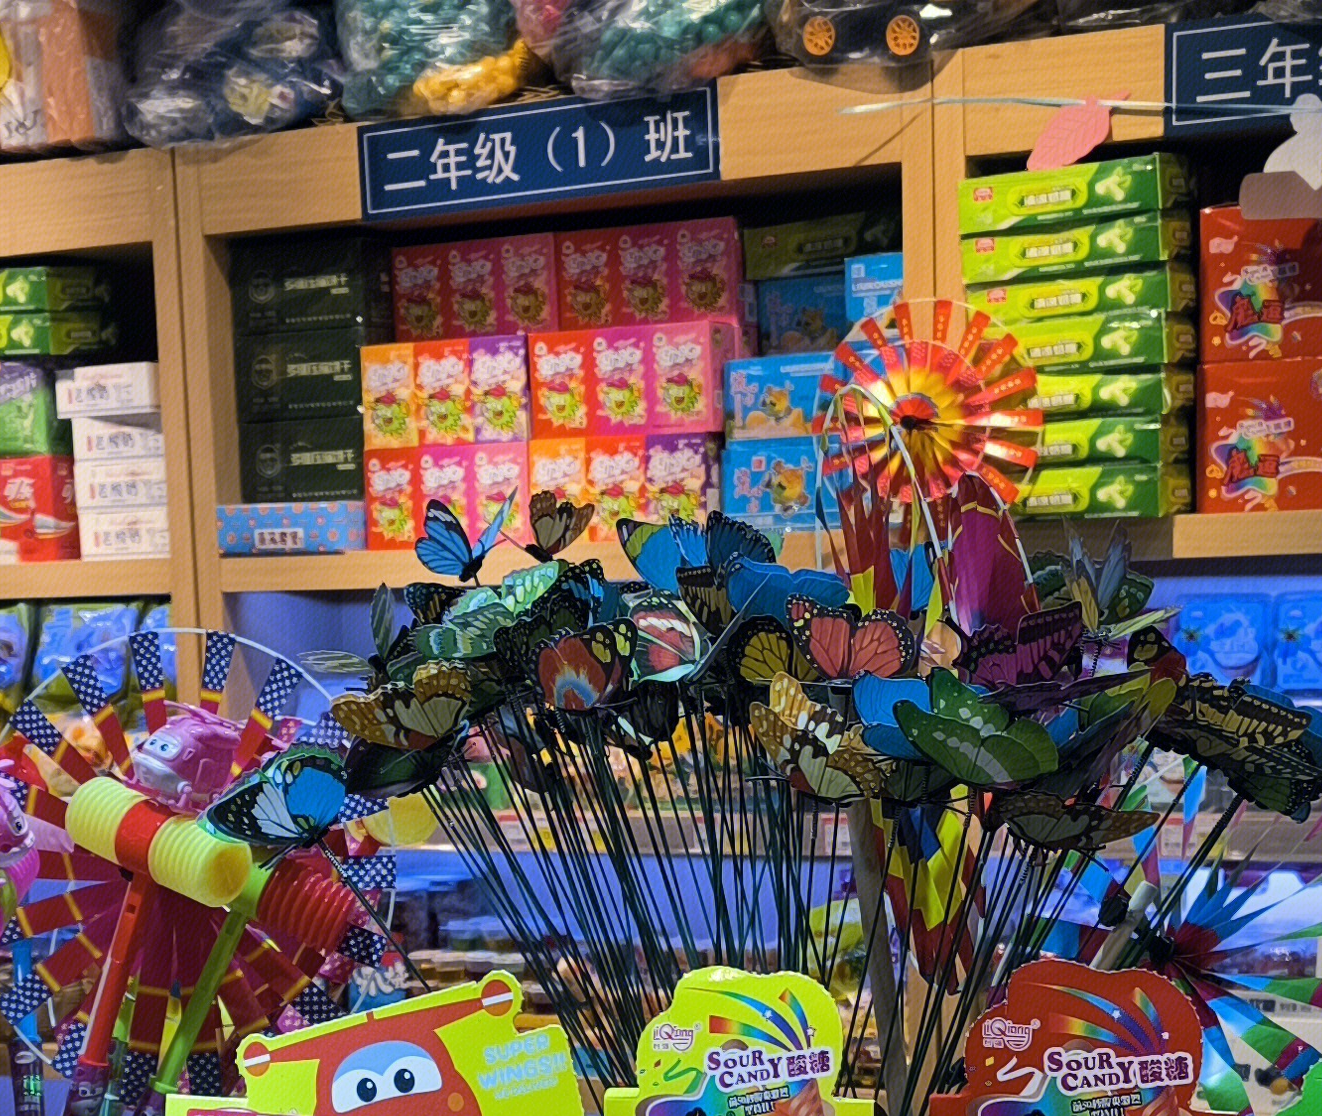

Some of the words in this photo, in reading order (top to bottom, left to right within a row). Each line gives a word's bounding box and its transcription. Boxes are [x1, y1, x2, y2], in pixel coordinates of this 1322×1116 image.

[383, 111, 693, 191] 二年级（1）班
[484, 1034, 550, 1065] SUPER
[708, 1050, 765, 1071] SOUR
[1048, 1052, 1113, 1072] SOUR
[719, 1056, 783, 1088] CANDY
[787, 1050, 830, 1078] 酸糖
[1061, 1061, 1134, 1091] CANDY
[1138, 1056, 1189, 1083] 酸糖
